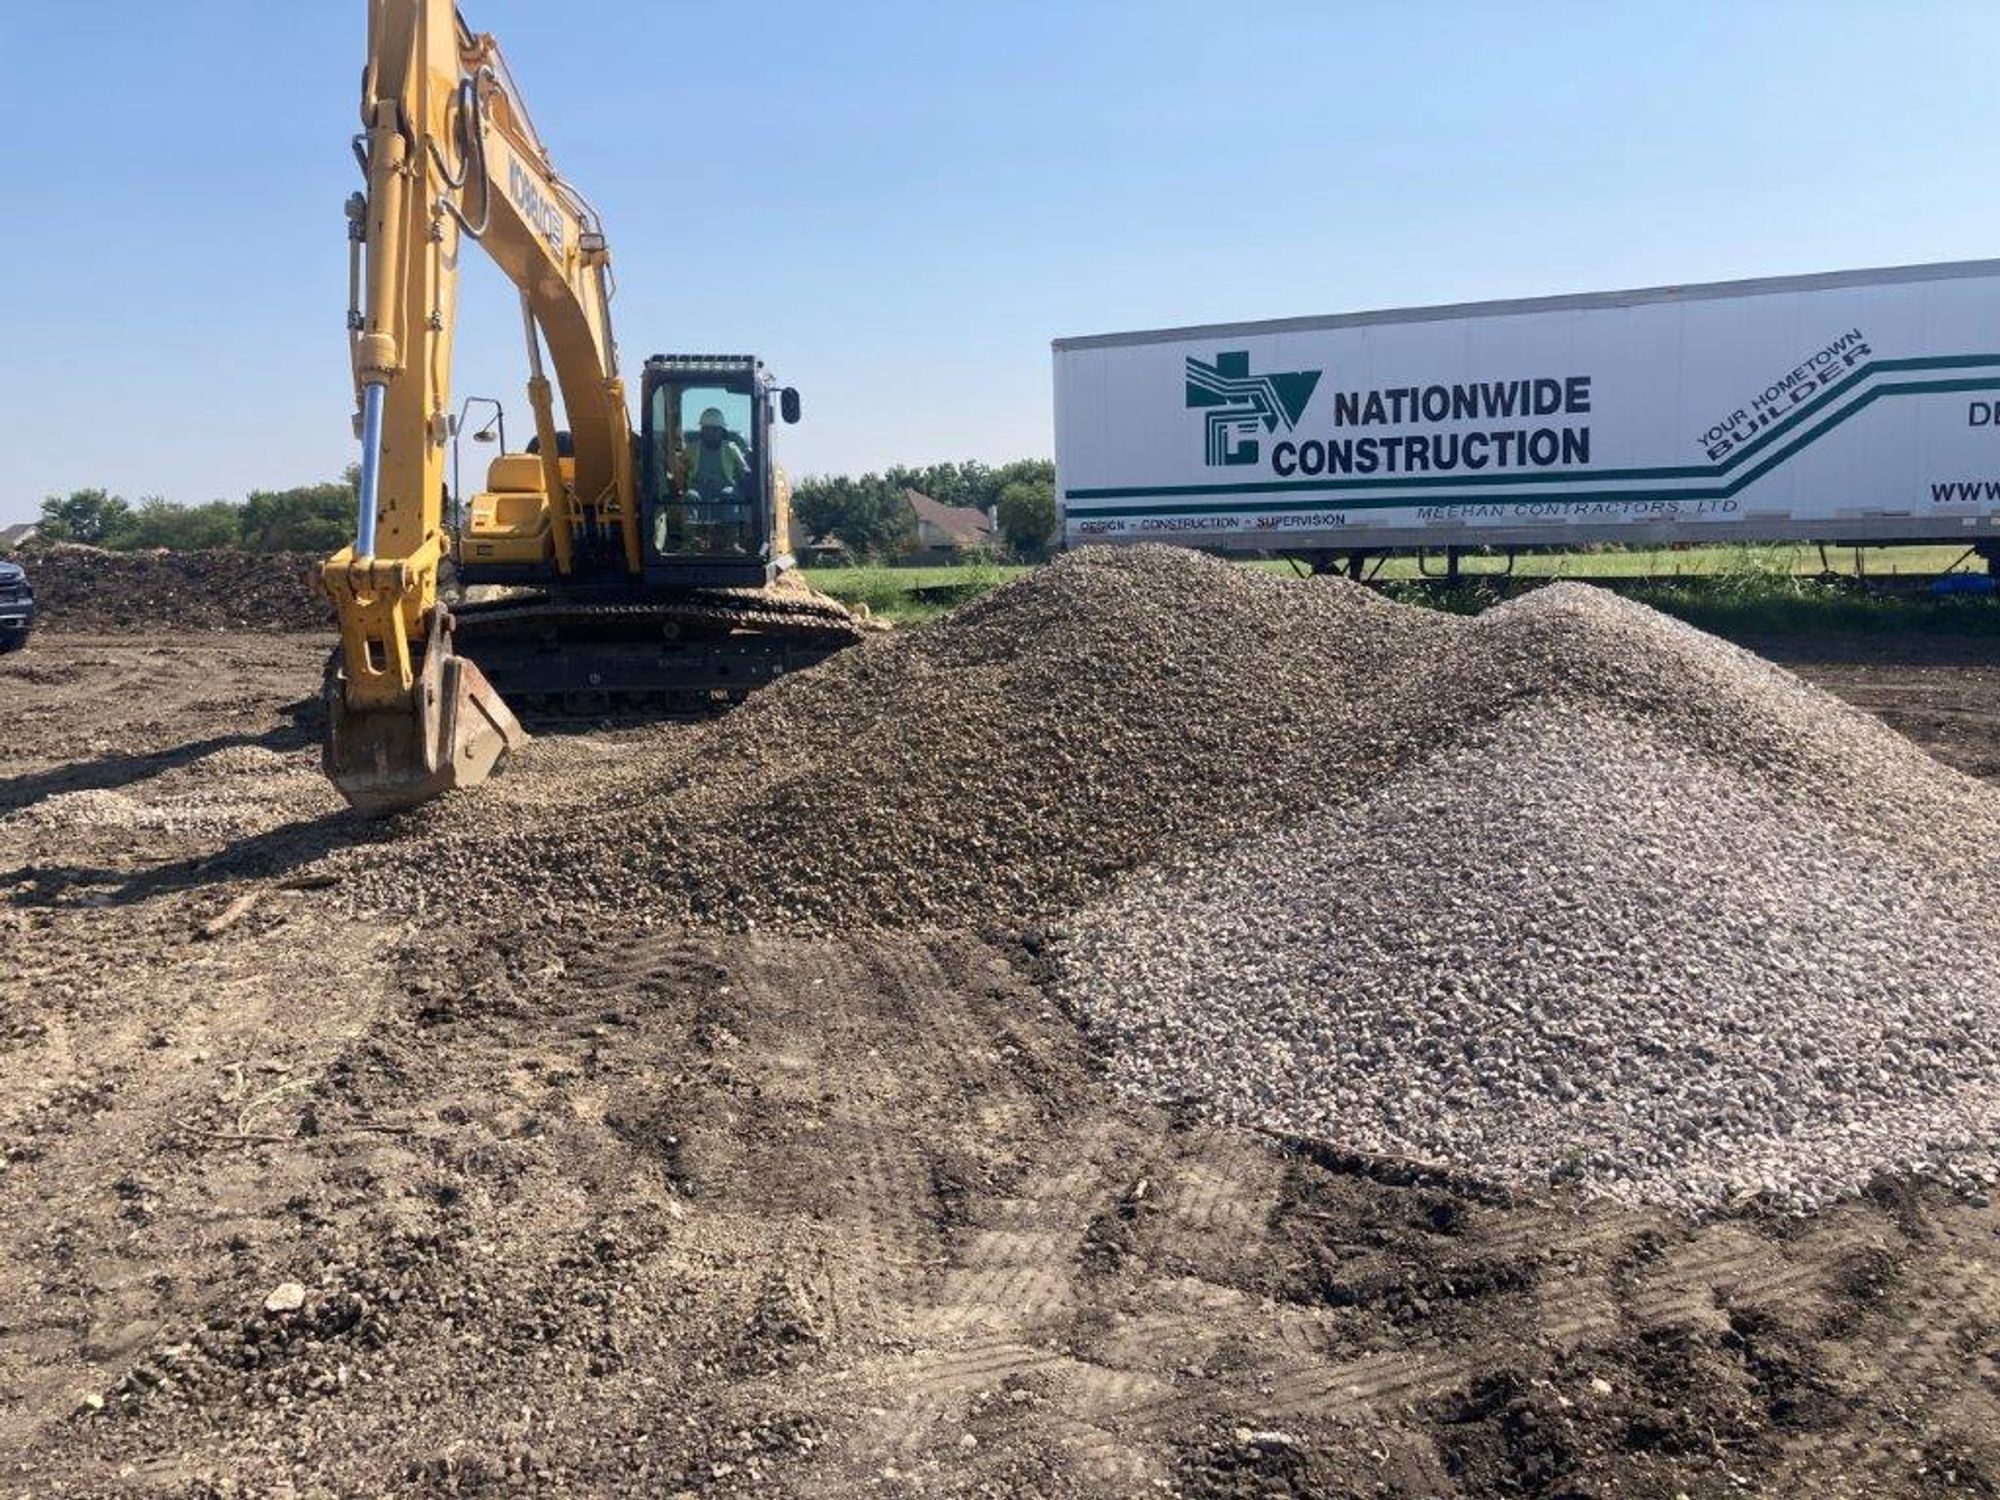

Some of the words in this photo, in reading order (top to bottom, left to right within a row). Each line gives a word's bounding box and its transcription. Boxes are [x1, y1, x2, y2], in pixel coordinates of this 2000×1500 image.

[1333, 376, 1591, 427] NATIONWIDE
[1697, 409, 1748, 447] YOUR
[1751, 328, 1863, 411] HOMETOWN
[1706, 343, 1872, 461] BUILDER
[1271, 427, 1590, 477] CONSTRUCTION
[1080, 520, 1125, 533] DESIGN
[1141, 517, 1239, 531] CONSTRUCTION
[1256, 513, 1345, 528] SUPERVISION
[1417, 504, 1504, 519] MEEHAN
